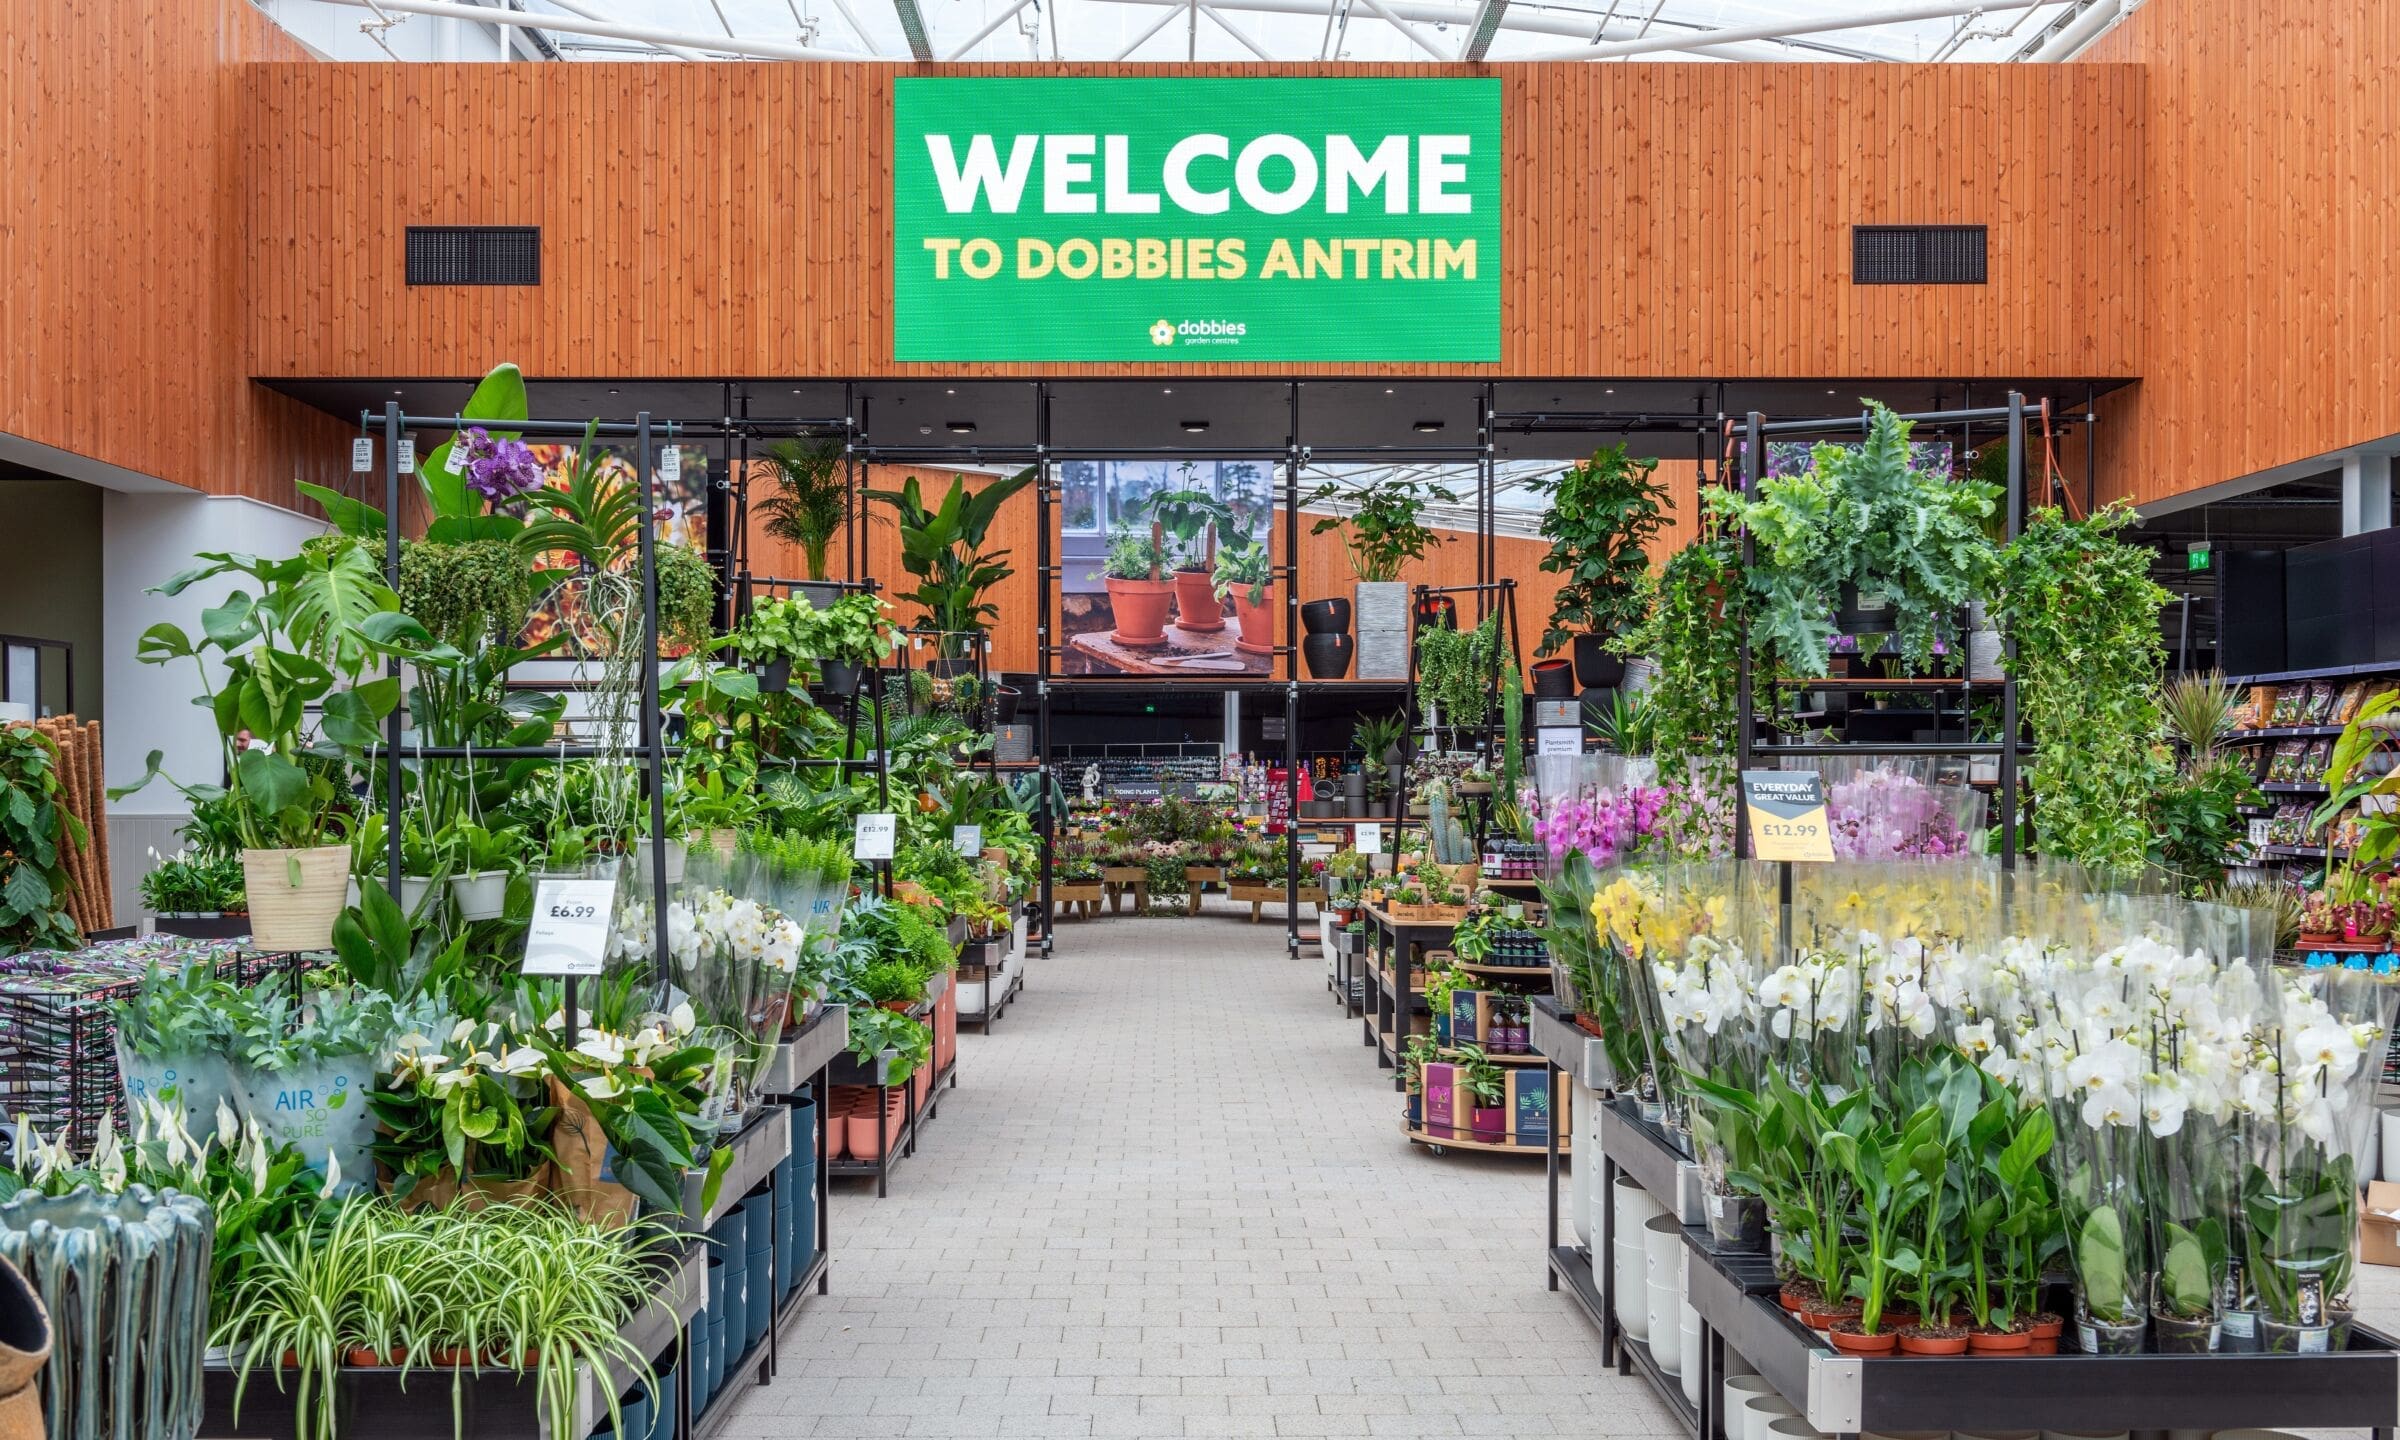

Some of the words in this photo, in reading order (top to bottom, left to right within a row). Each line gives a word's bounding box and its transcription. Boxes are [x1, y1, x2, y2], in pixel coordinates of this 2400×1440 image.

[924, 133, 1473, 215] WELCOME
[923, 238, 1004, 280] TO
[1016, 238, 1248, 280] DOBBIES
[1258, 238, 1477, 280] ANTRIM
[1177, 319, 1247, 336] dobbies
[1184, 337, 1211, 346] garden
[1211, 337, 1240, 345] centres
[1753, 783, 1813, 792] EVERYDAY
[1754, 793, 1784, 801] GREAT
[1763, 824, 1817, 837] £12.99
[550, 905, 595, 918] £6.99
[812, 900, 830, 914] AIR
[127, 1075, 148, 1099] AIR
[275, 1089, 315, 1111] AIR
[305, 1108, 328, 1123] SO
[283, 1125, 323, 1139] PURE
